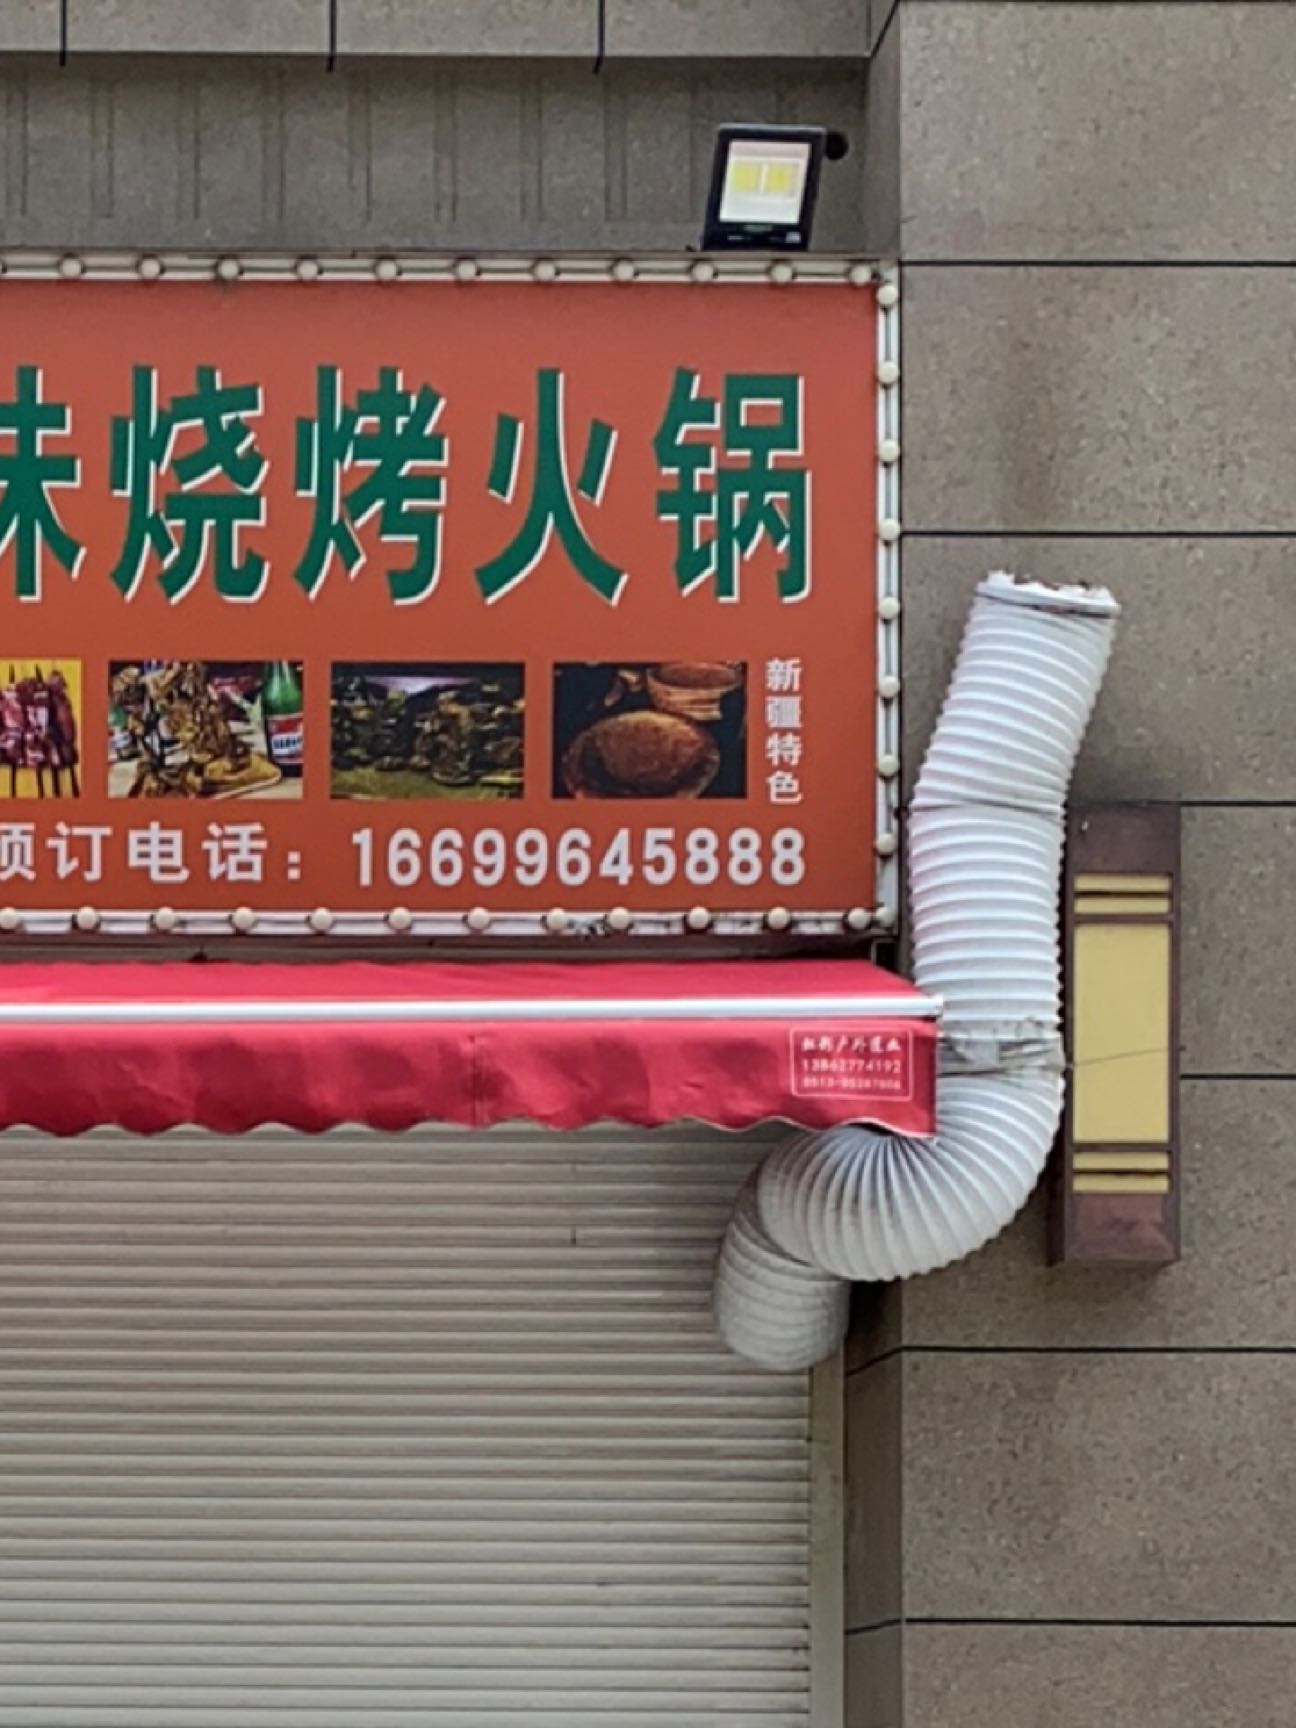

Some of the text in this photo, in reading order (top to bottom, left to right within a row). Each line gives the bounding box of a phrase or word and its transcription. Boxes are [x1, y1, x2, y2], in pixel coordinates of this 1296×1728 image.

[765, 656, 803, 805] 新疆特色
[351, 828, 807, 888] 16699645888
